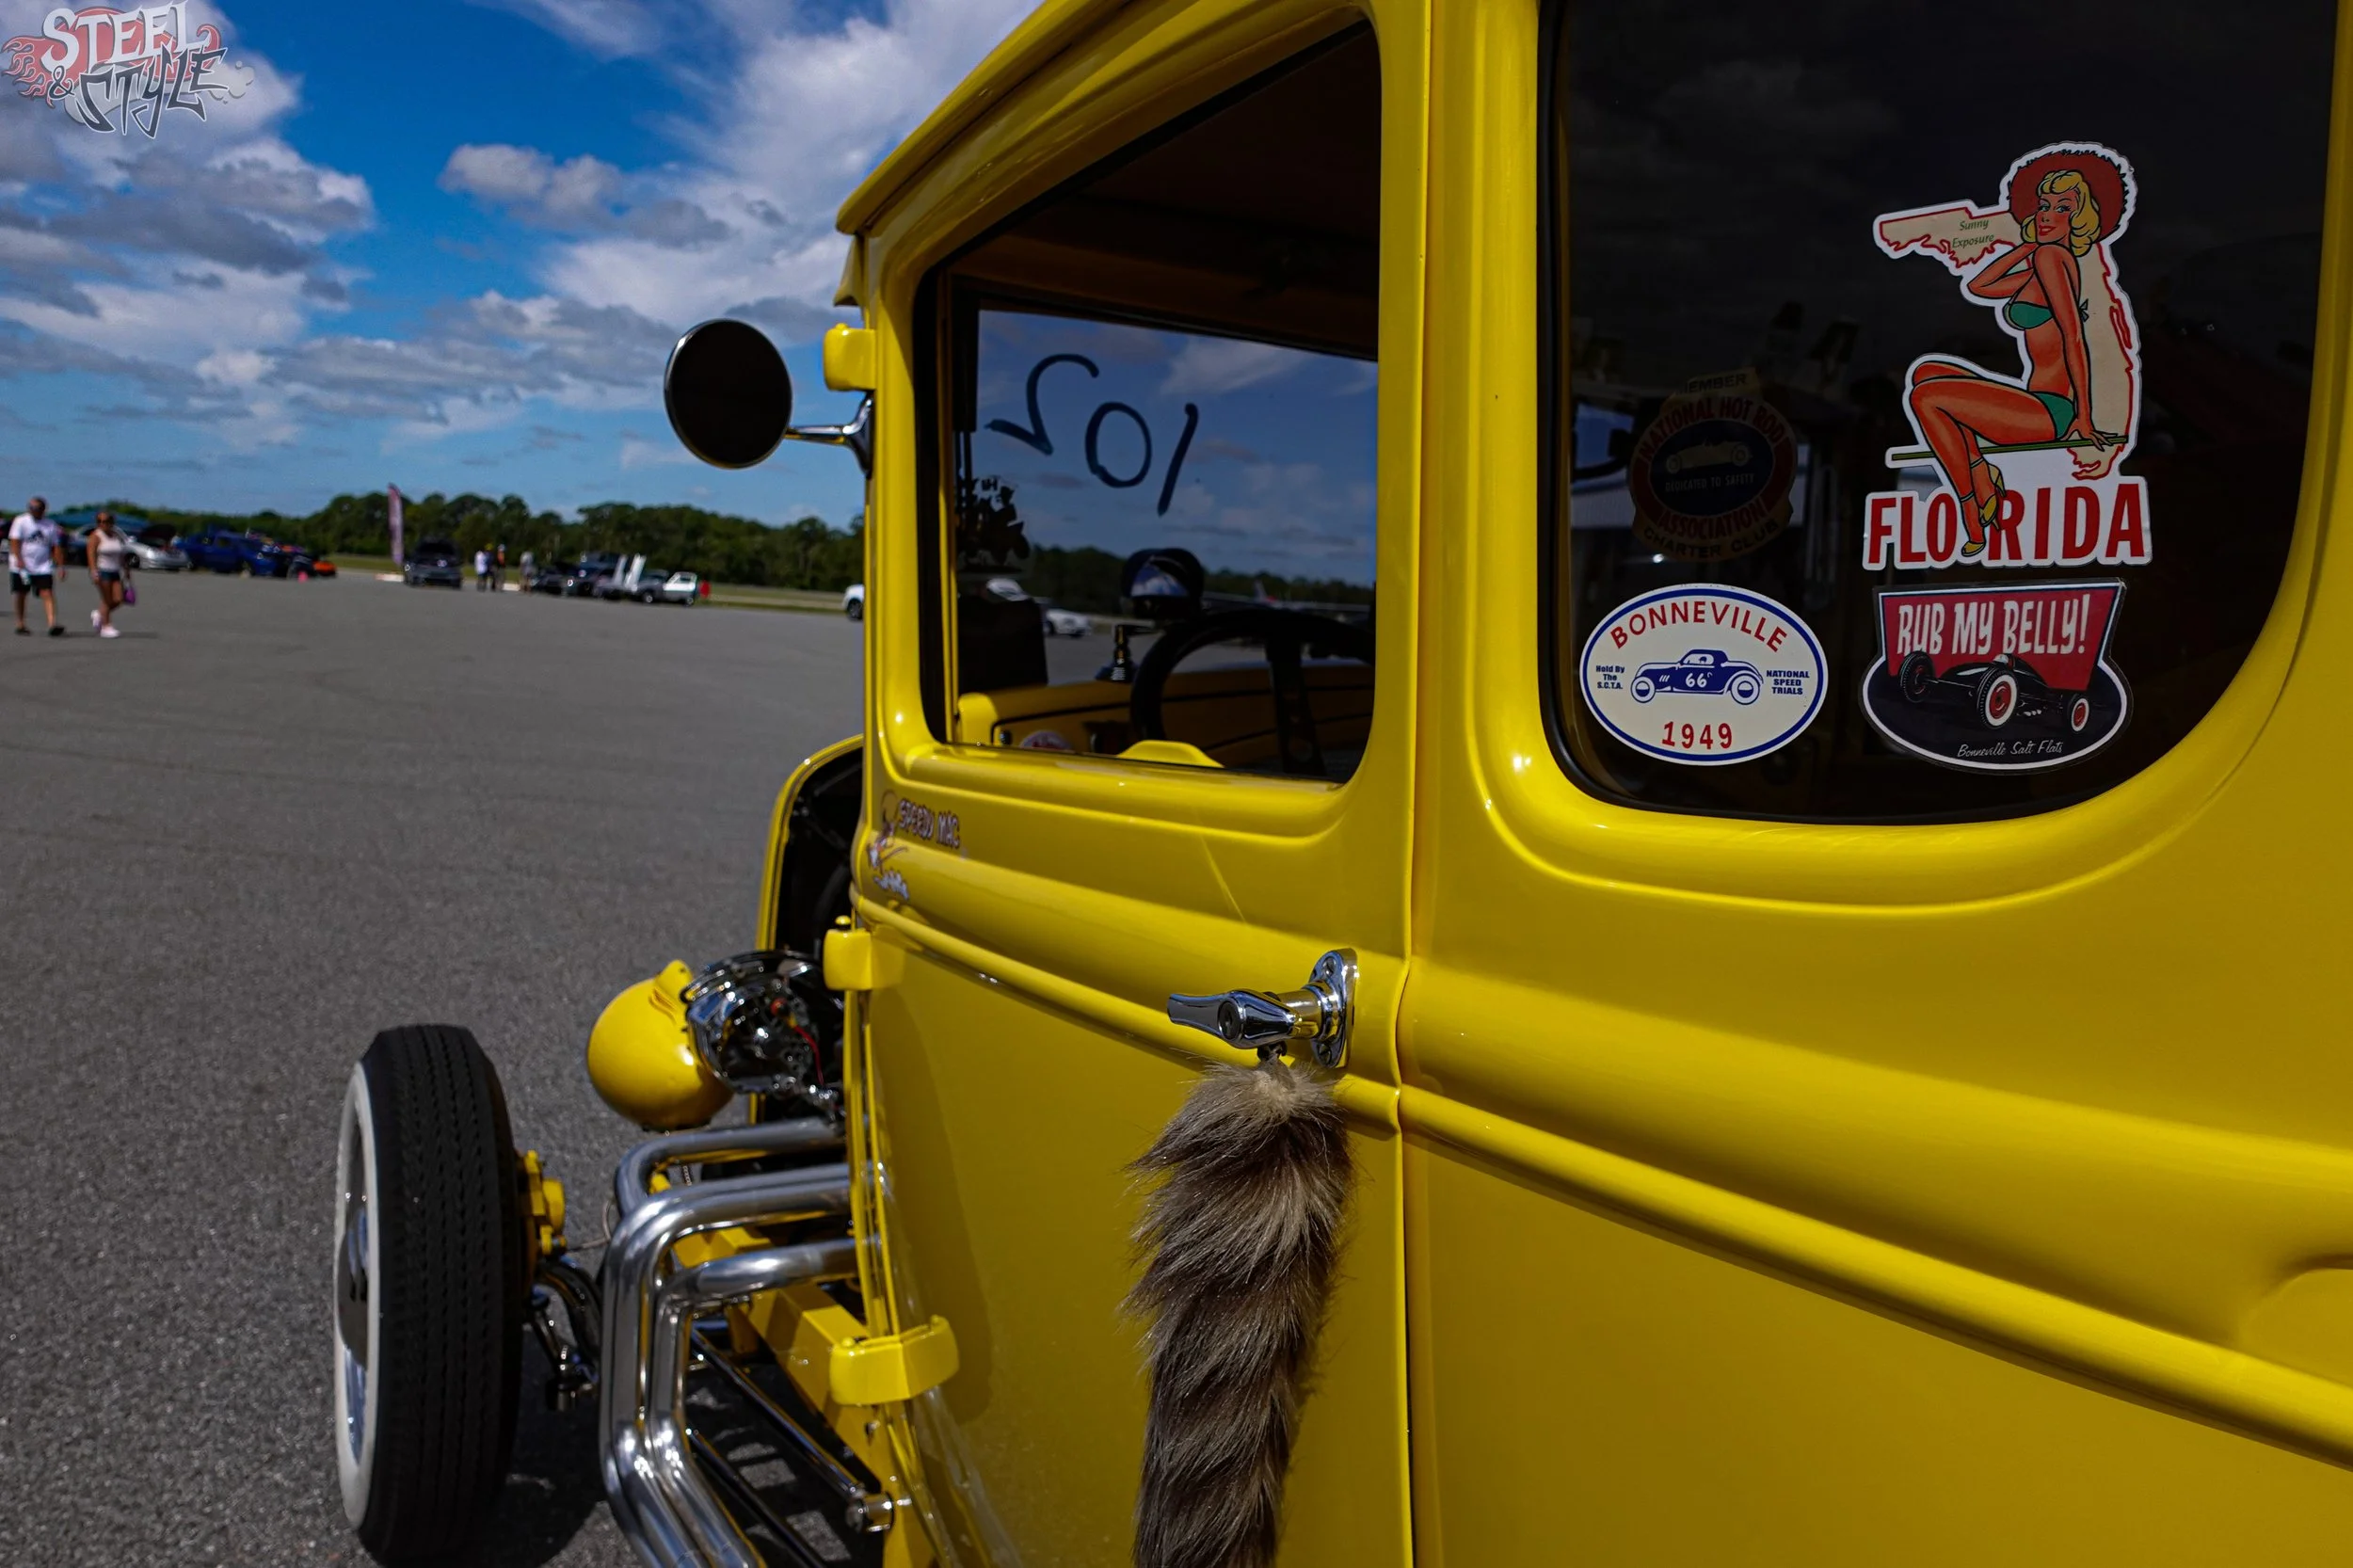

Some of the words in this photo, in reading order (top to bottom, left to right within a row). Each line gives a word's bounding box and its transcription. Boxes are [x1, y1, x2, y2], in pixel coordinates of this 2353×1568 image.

[1960, 220, 1989, 231] Sunny
[1952, 234, 1994, 248] Exposure
[1640, 397, 1715, 459] NATIONAL
[1721, 397, 1753, 421] HOT
[1753, 405, 1785, 444] ROD
[1665, 478, 1706, 493] DEDICATED
[1710, 476, 1721, 488] TO
[1725, 473, 1755, 487] SAFETY
[1658, 499, 1769, 539] ASSOCIATION
[1868, 483, 2145, 564] FLORIDA
[1643, 526, 1721, 559] CHARTER
[1731, 519, 1779, 552] CLUB
[1610, 600, 1787, 652] BONNEVILLE
[1897, 602, 1945, 657] RUB
[1951, 601, 1994, 655] MY
[2002, 593, 2090, 655] BELLY!
[1615, 665, 1625, 674] By
[1766, 670, 1810, 679] NATIONAL
[1771, 686, 1803, 696] TRIALS
[1773, 678, 1801, 686] SPEED
[1661, 721, 1733, 750] 1949
[1958, 743, 2006, 757] Bonneville
[2010, 741, 2036, 755] Salt
[2038, 740, 2064, 753] Flats
